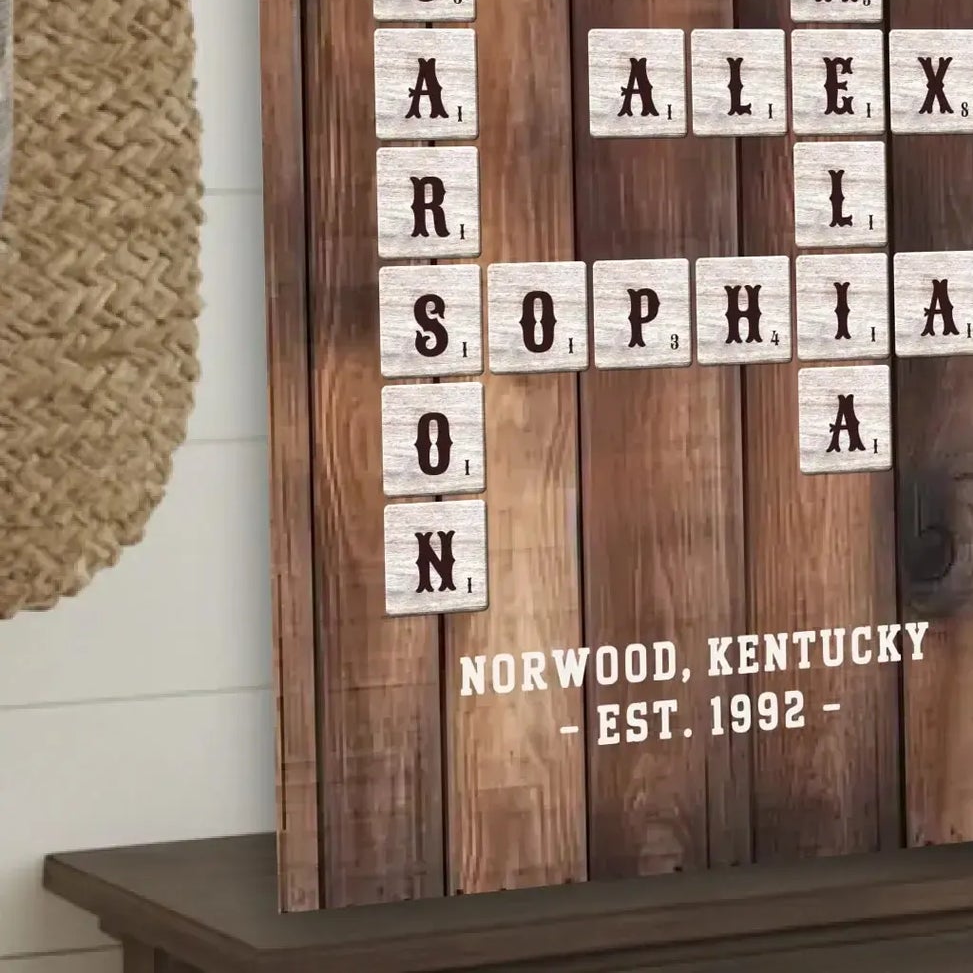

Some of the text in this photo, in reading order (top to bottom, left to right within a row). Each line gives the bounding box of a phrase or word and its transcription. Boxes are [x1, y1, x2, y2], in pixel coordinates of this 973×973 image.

[617, 56, 954, 118] ALEX
[961, 102, 969, 118] 8
[413, 278, 960, 358] SOPHIA
[670, 333, 679, 350] 3
[770, 330, 780, 346] 4
[459, 621, 929, 697] NORWOOD, KENTUCKY
[596, 699, 693, 746] EST.
[710, 690, 805, 736] 1992
